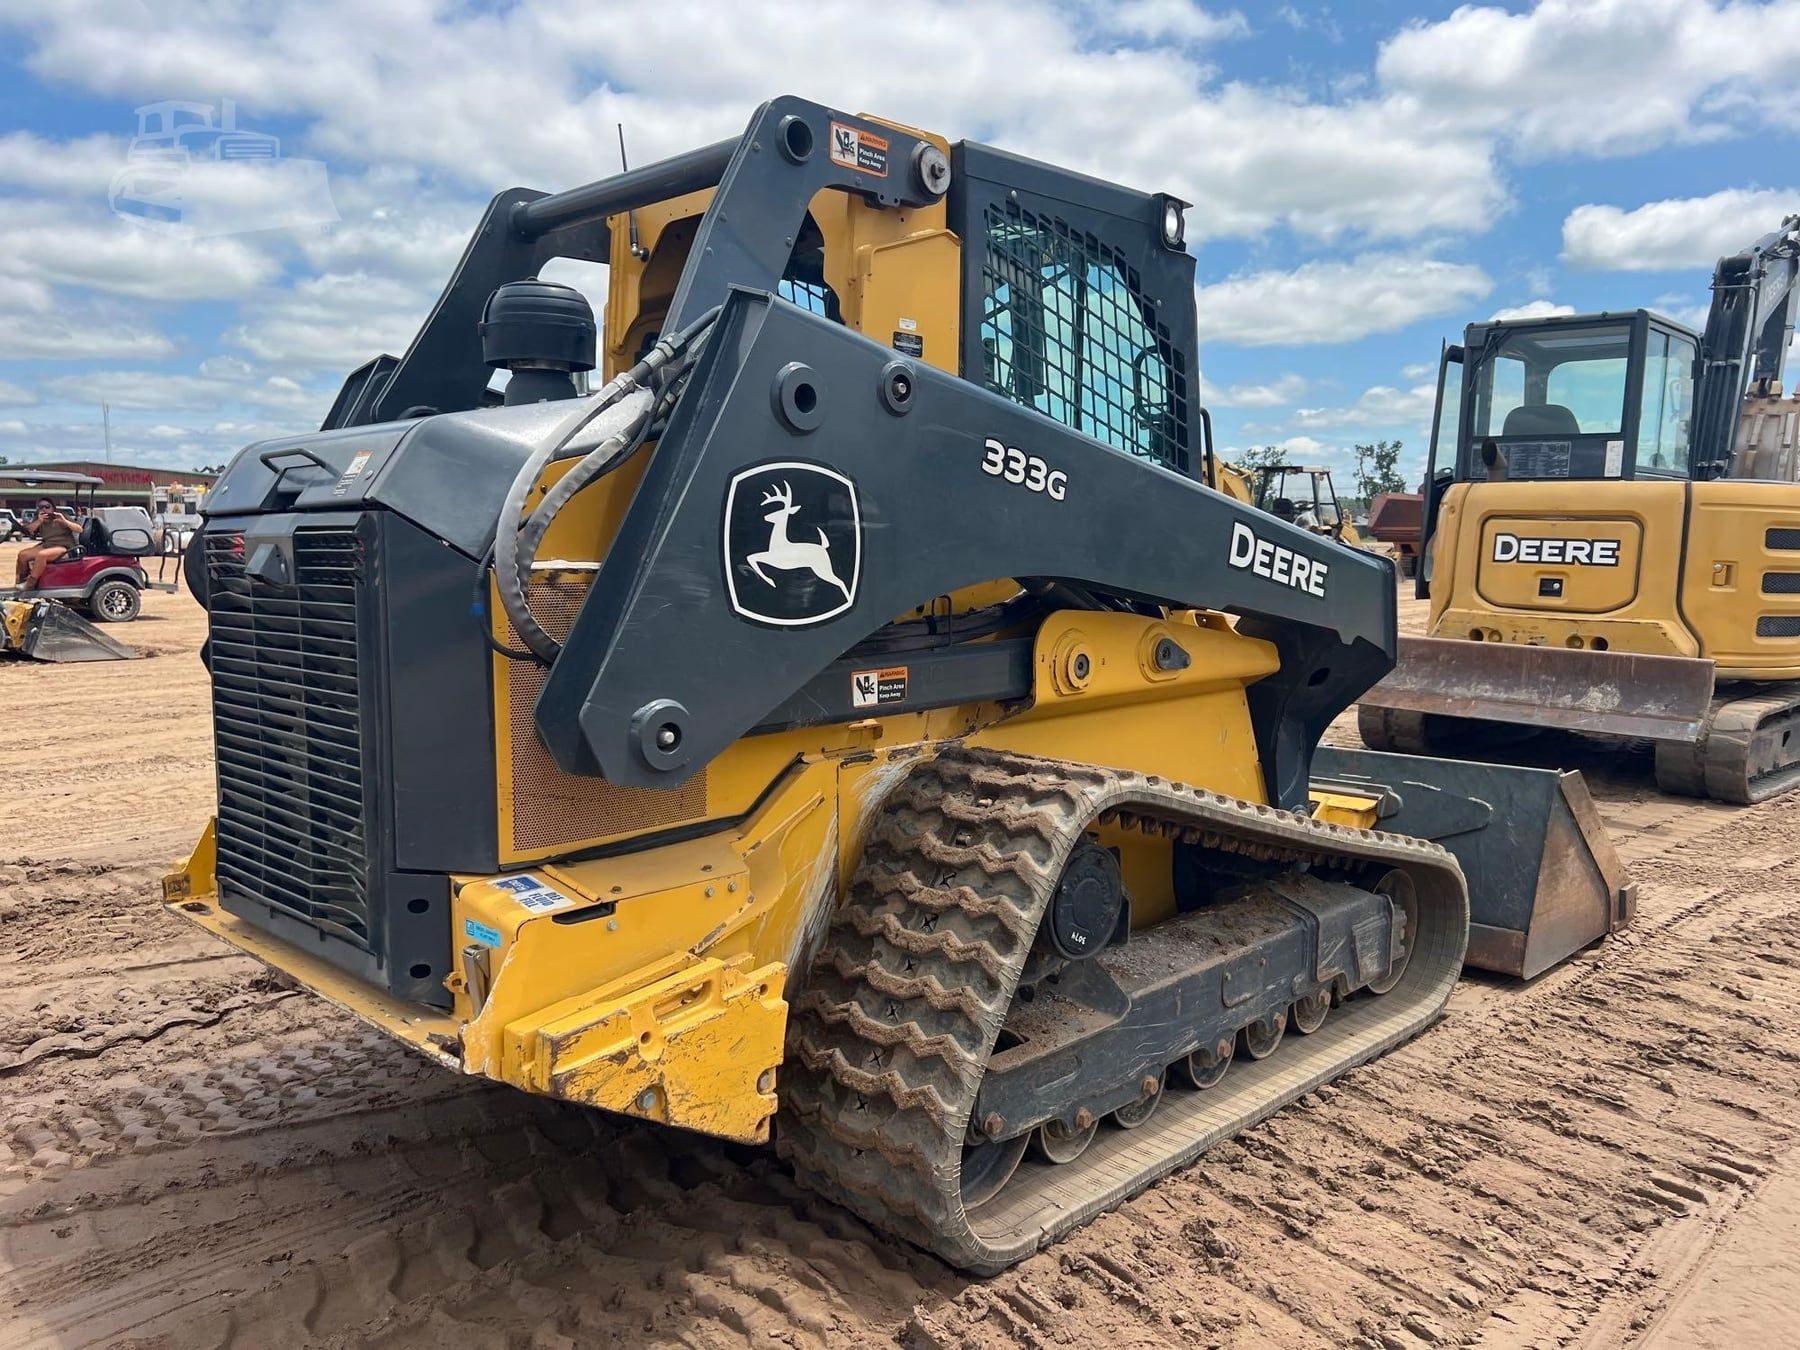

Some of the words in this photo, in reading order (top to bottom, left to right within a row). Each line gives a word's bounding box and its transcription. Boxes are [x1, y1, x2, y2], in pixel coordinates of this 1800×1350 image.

[859, 147, 873, 158] Pinch
[873, 152, 885, 162] Area
[859, 156, 870, 166] Keep
[870, 160, 881, 169] Away
[982, 438, 1068, 501] 333G
[1228, 522, 1329, 598] DEERE
[1493, 535, 1619, 565] DEERE
[879, 684, 892, 692] Pinch
